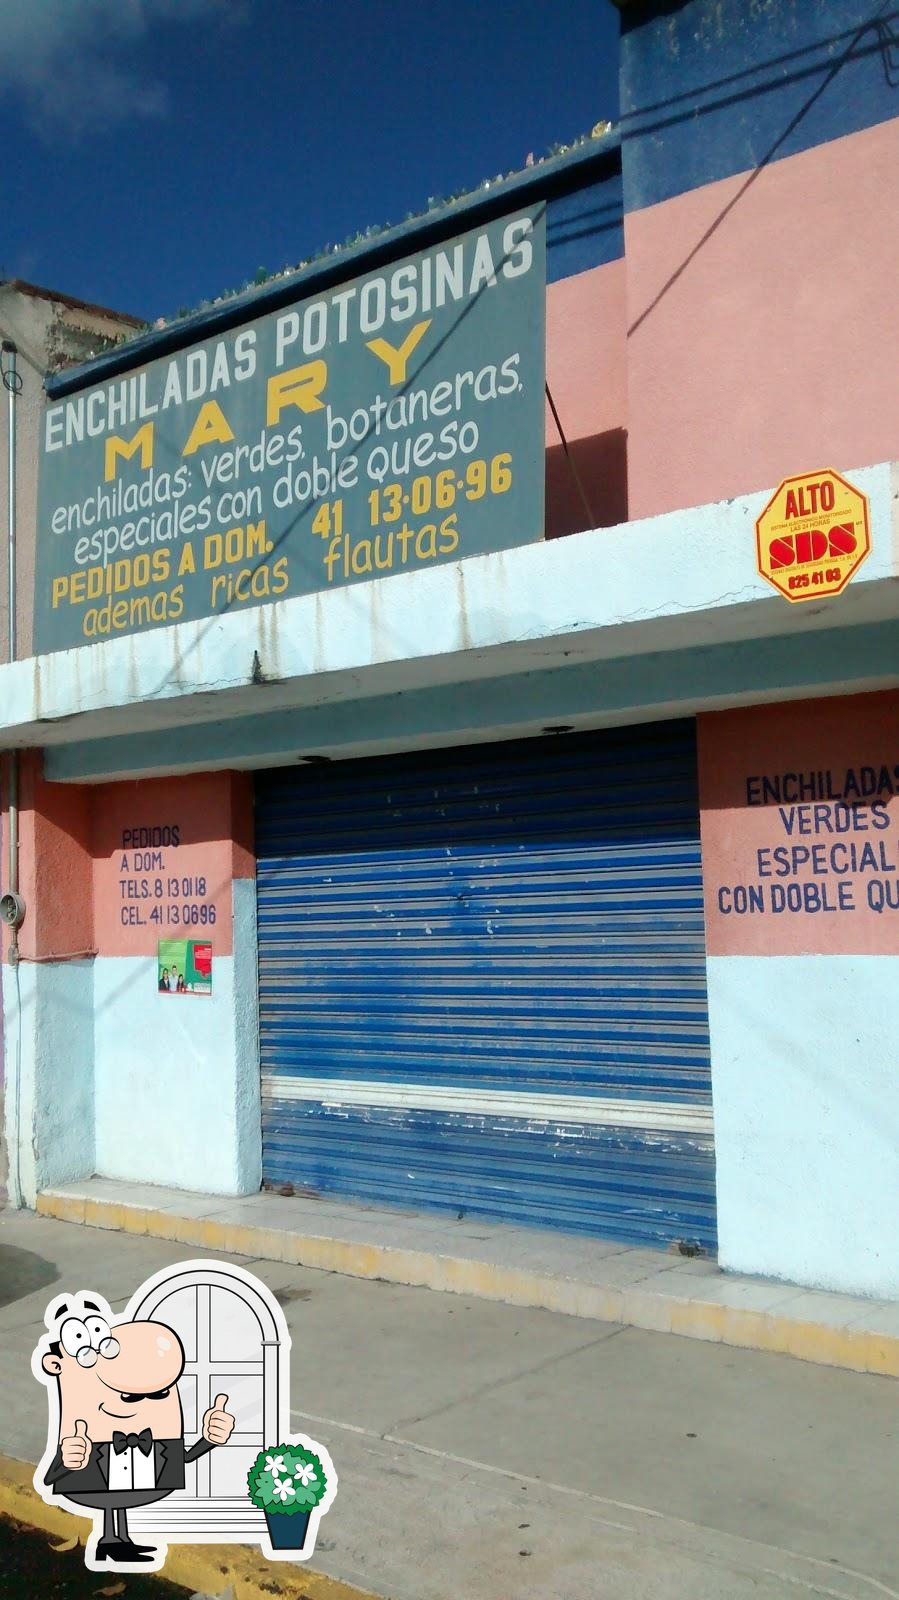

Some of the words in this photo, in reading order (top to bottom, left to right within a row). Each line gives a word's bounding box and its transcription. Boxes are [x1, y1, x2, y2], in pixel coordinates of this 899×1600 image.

[45, 330, 257, 452] ENCHILADAS
[275, 217, 534, 367] POTOSINAS
[104, 318, 433, 483] MARY
[51, 464, 192, 534] enchiladas:
[74, 495, 211, 568] especiales
[217, 486, 262, 523] con
[273, 451, 358, 508] doble
[785, 480, 835, 520] ALTO
[52, 548, 170, 608] PEDIDOS
[178, 542, 195, 576] A
[203, 520, 274, 569] DOM.
[311, 499, 343, 539] 41
[769, 522, 857, 570] SDS
[82, 584, 184, 637] ademas
[211, 556, 288, 608] ricas
[323, 513, 459, 581] flautas
[812, 570, 824, 585] 41
[122, 825, 180, 849] PEDIDOS
[779, 800, 890, 835] VERDES
[120, 854, 129, 872] A
[134, 852, 165, 871] DOM.
[121, 906, 147, 925] CEL.
[718, 885, 765, 914] CON
[771, 881, 855, 913] DOBLE
